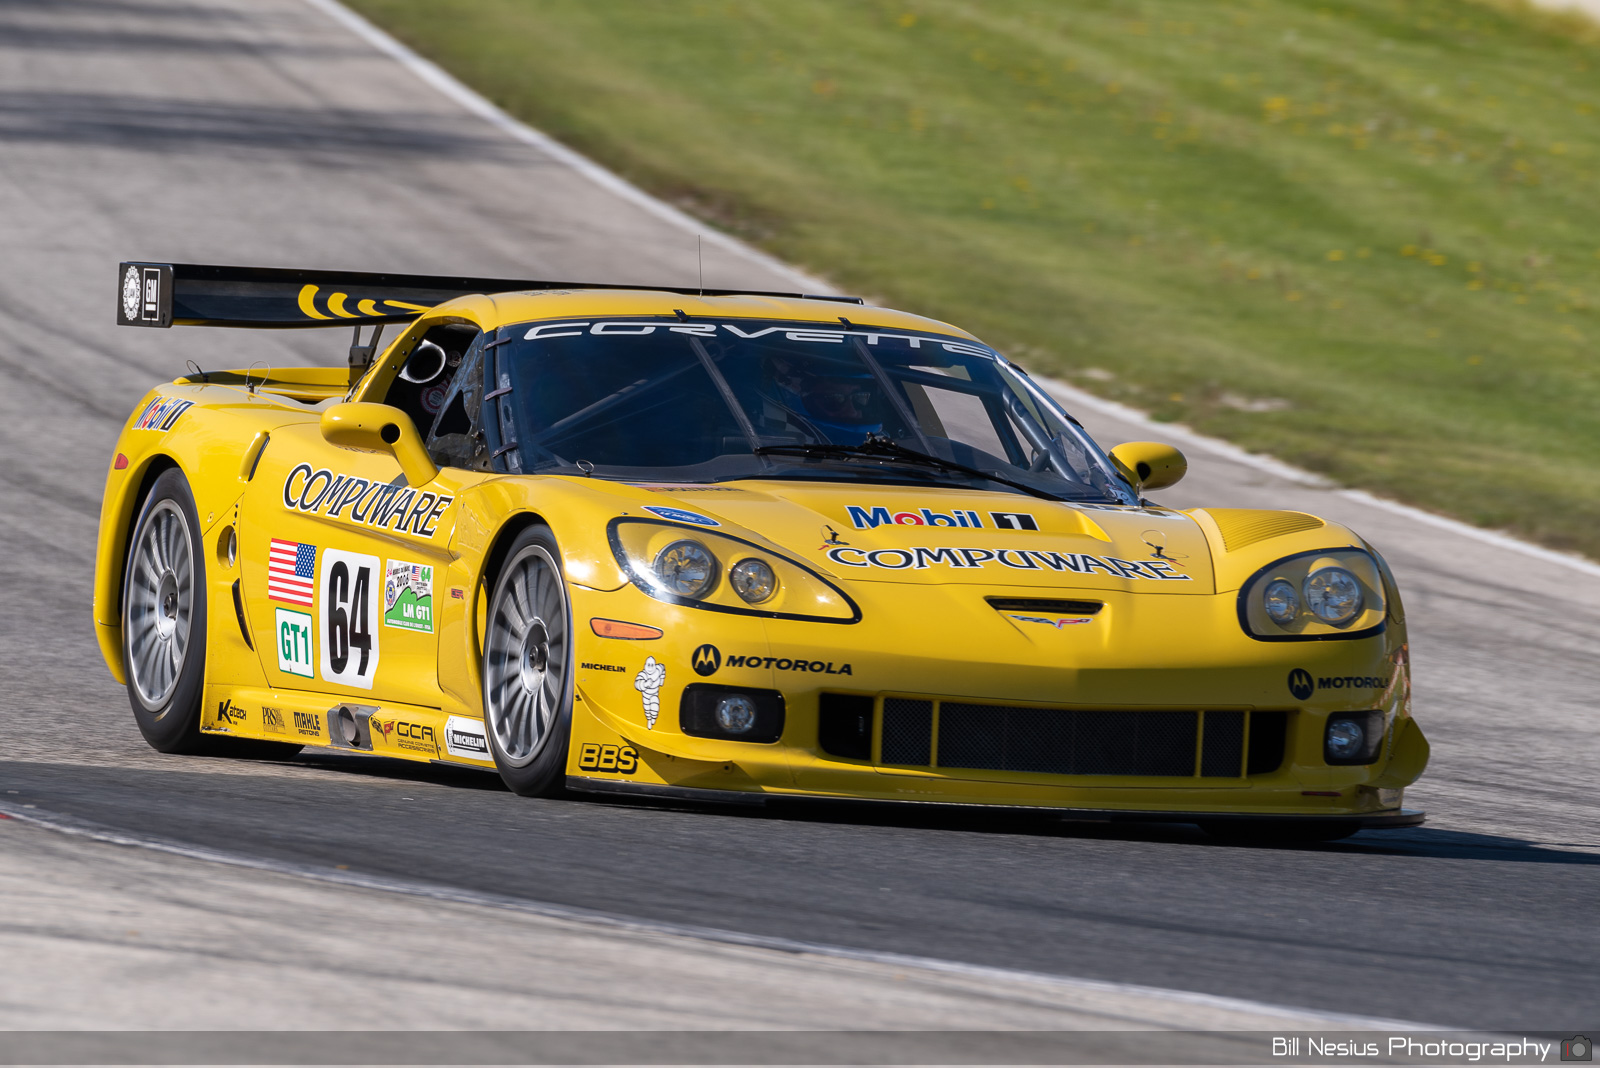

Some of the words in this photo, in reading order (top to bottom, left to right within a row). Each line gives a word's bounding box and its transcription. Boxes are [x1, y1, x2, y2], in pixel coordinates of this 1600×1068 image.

[145, 279, 157, 303] GM
[523, 322, 995, 360] CORVETTE
[132, 396, 183, 431] Mobil
[284, 462, 454, 538] COMPUWARE
[846, 505, 983, 530] Mobil
[421, 567, 431, 582] 64
[826, 547, 1193, 582] COMPUWARE
[328, 560, 372, 677] 64
[403, 603, 415, 619] LM
[416, 605, 430, 621] GT1
[281, 620, 309, 666] GT1
[580, 662, 626, 673] MICHELIN
[726, 655, 853, 676] MOTOROLA
[294, 711, 321, 731] MAHLE
[298, 729, 320, 737] PISTONS
[397, 721, 434, 741] GCA
[453, 733, 485, 748] MICHELIN
[578, 743, 639, 774] BBS
